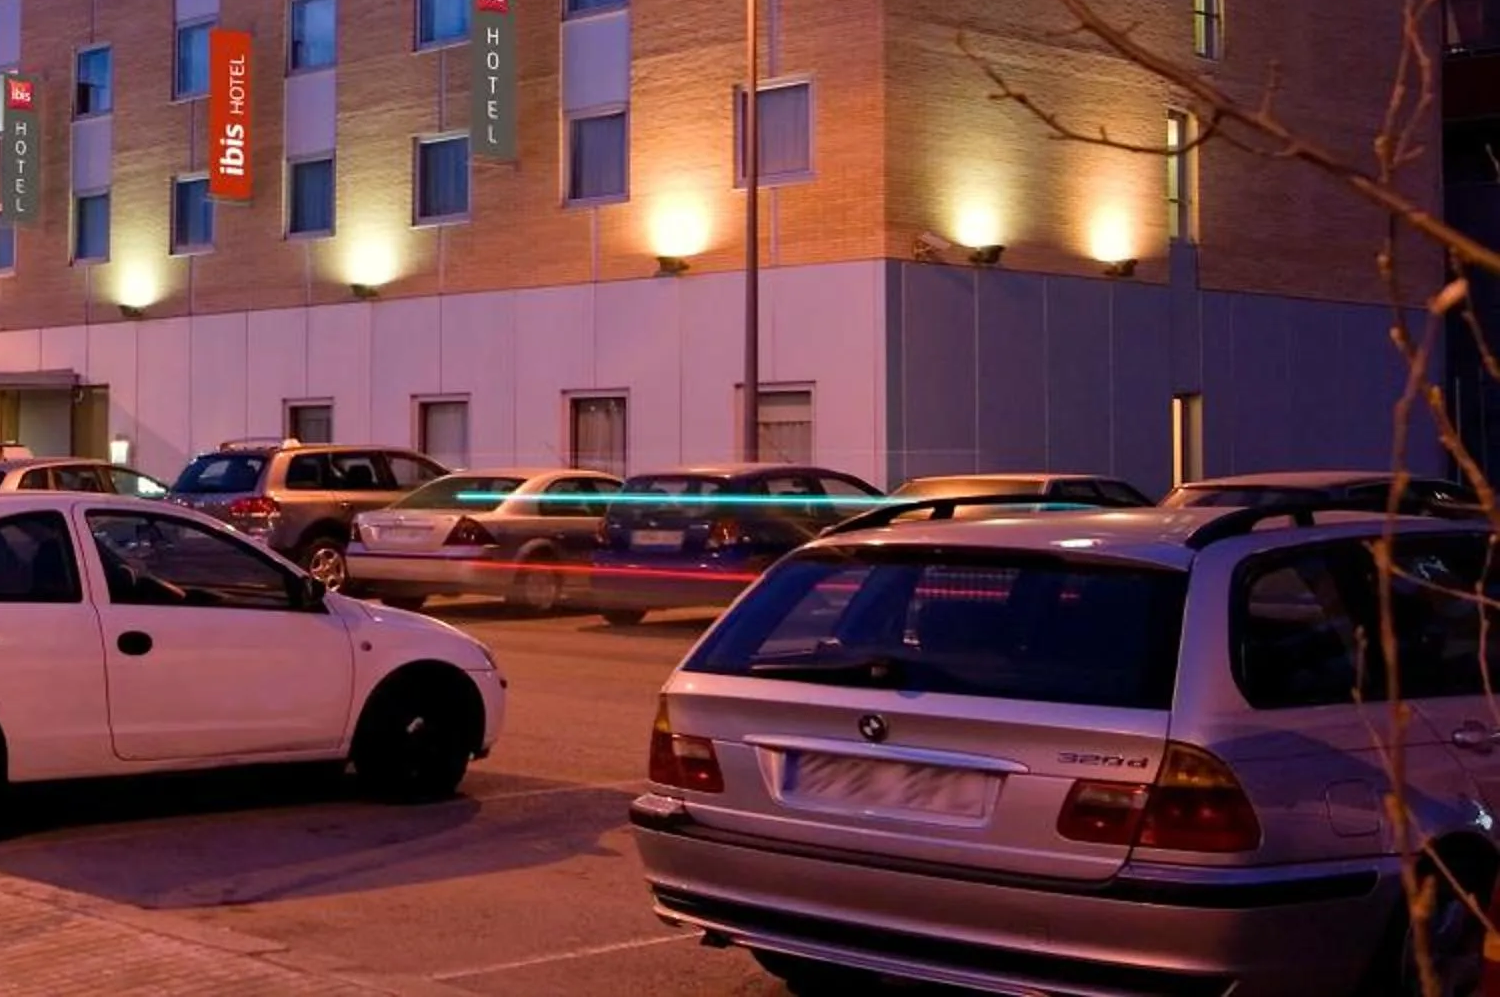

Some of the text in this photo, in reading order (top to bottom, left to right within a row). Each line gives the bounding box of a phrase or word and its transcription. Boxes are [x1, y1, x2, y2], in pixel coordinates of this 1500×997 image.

[11, 84, 31, 102] ibis
[219, 54, 245, 175] ibis HOTEL
[487, 27, 499, 144] HOTEL
[15, 122, 27, 212] HOTEL
